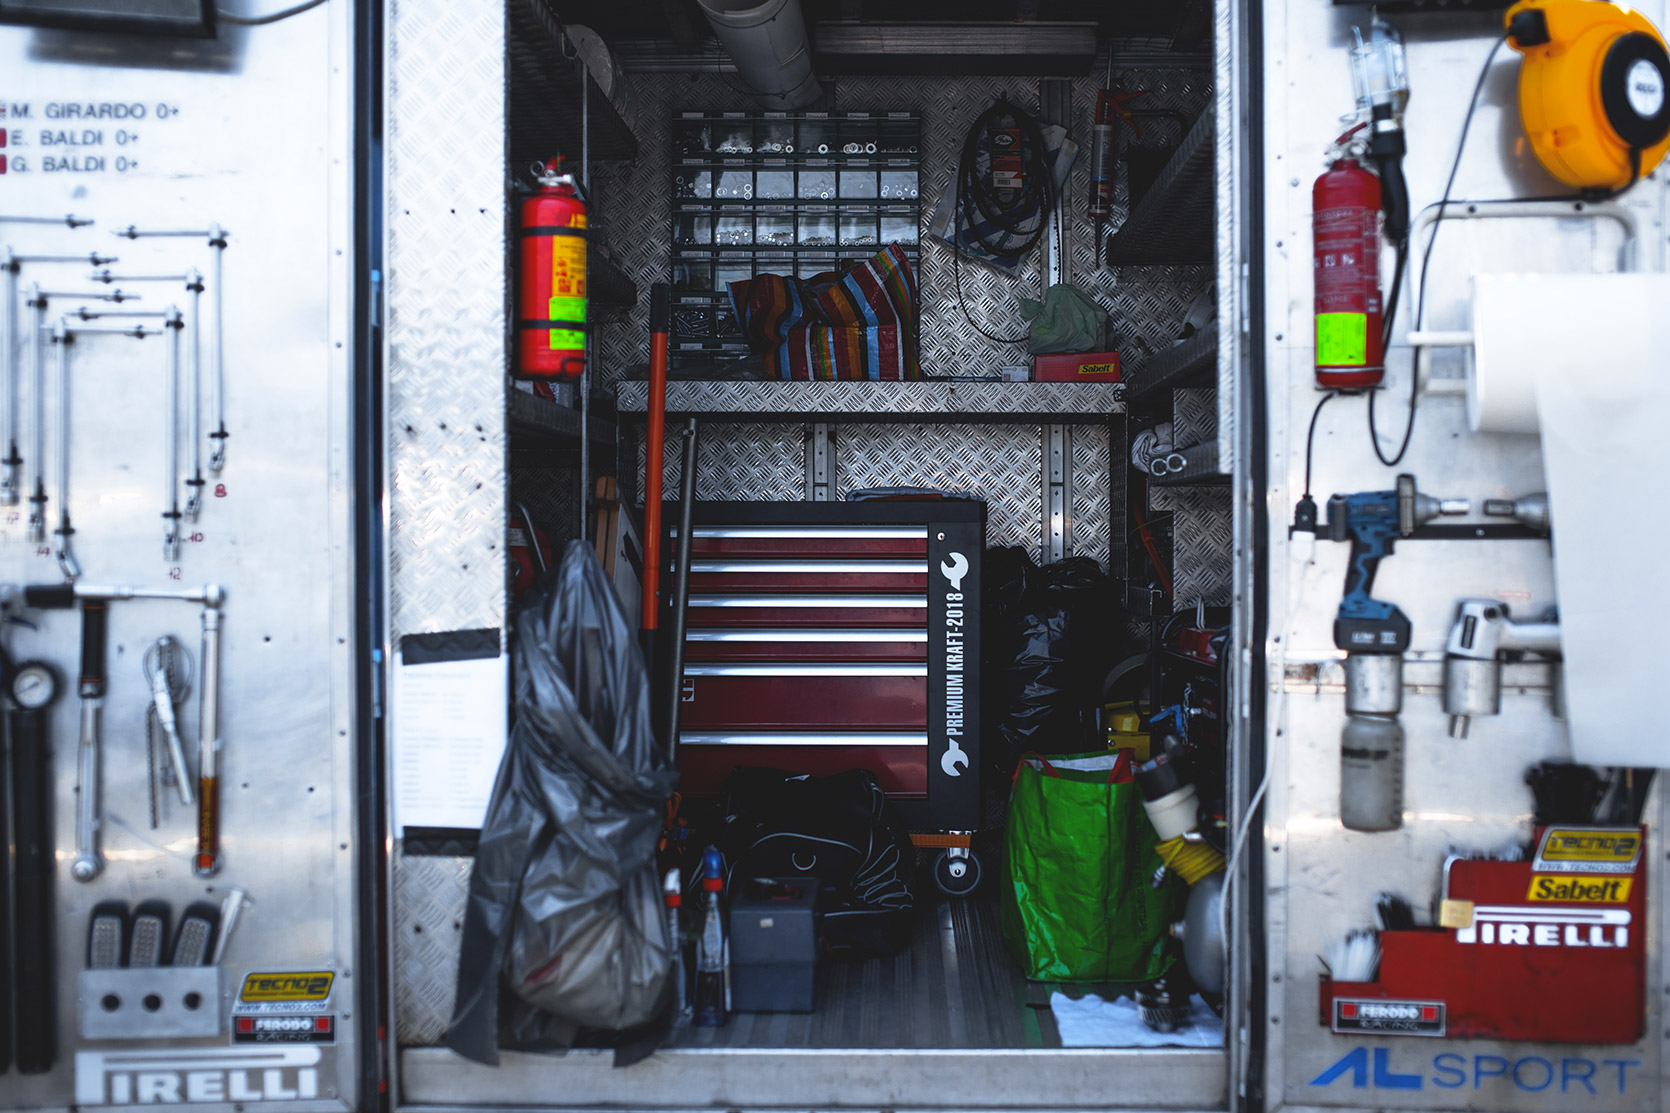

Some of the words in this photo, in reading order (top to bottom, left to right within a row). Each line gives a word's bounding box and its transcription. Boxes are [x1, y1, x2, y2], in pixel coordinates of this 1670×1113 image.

[45, 103, 146, 119] GIRARDO
[40, 130, 103, 146] BALDI
[43, 156, 104, 172] BALDI
[1082, 364, 1111, 373] Sabelt
[946, 592, 964, 671] KRAFT-2018
[946, 674, 964, 736] PREMIUM
[1535, 878, 1622, 901] Sabelt
[1360, 1004, 1419, 1019] FERODO
[255, 1018, 312, 1031] FERODO
[75, 1044, 321, 1105] PIRELLI
[1307, 1046, 1423, 1091] AL
[1431, 1053, 1642, 1095] SPORT
